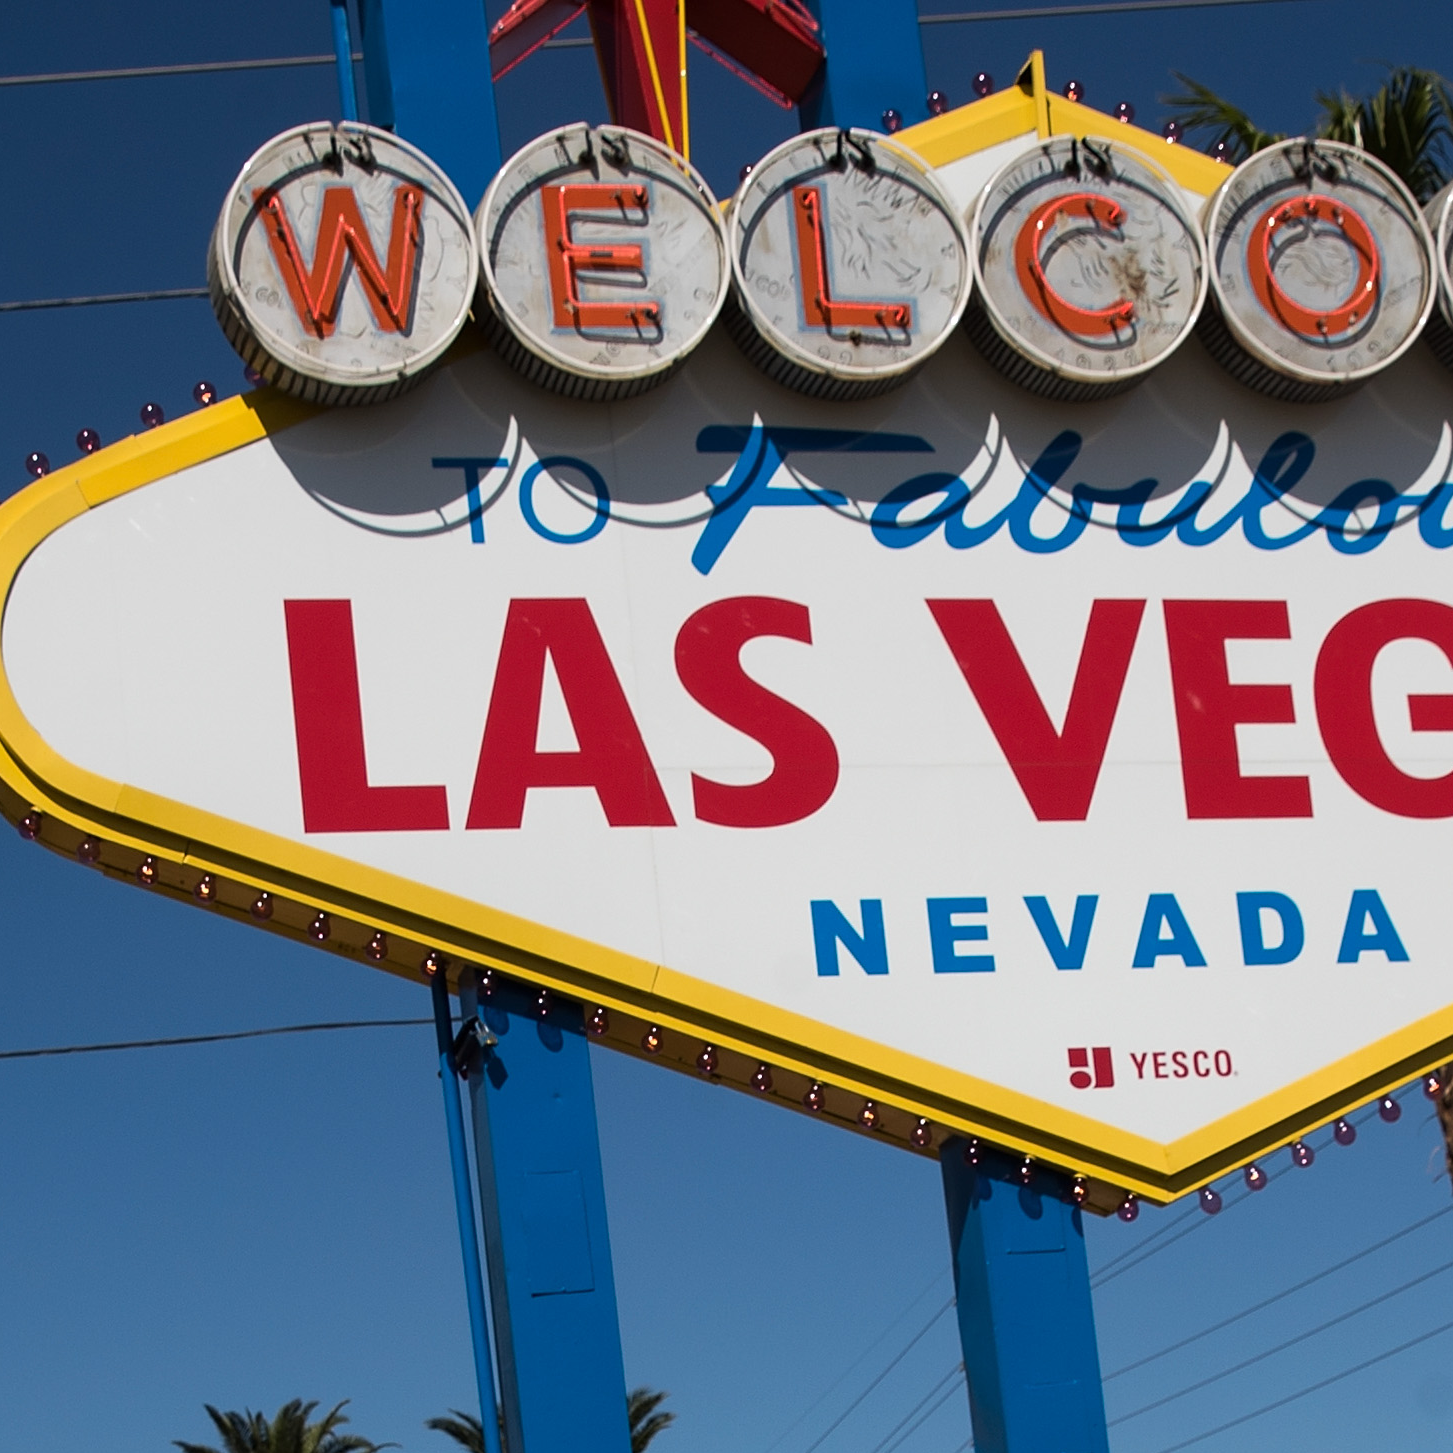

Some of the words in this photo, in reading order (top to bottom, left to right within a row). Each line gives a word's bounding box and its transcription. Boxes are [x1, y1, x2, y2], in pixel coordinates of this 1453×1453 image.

[431, 457, 610, 545] TO
[283, 596, 839, 833] LAS
[810, 889, 1410, 977] NEVADA
[1130, 1050, 1232, 1079] YESCO
